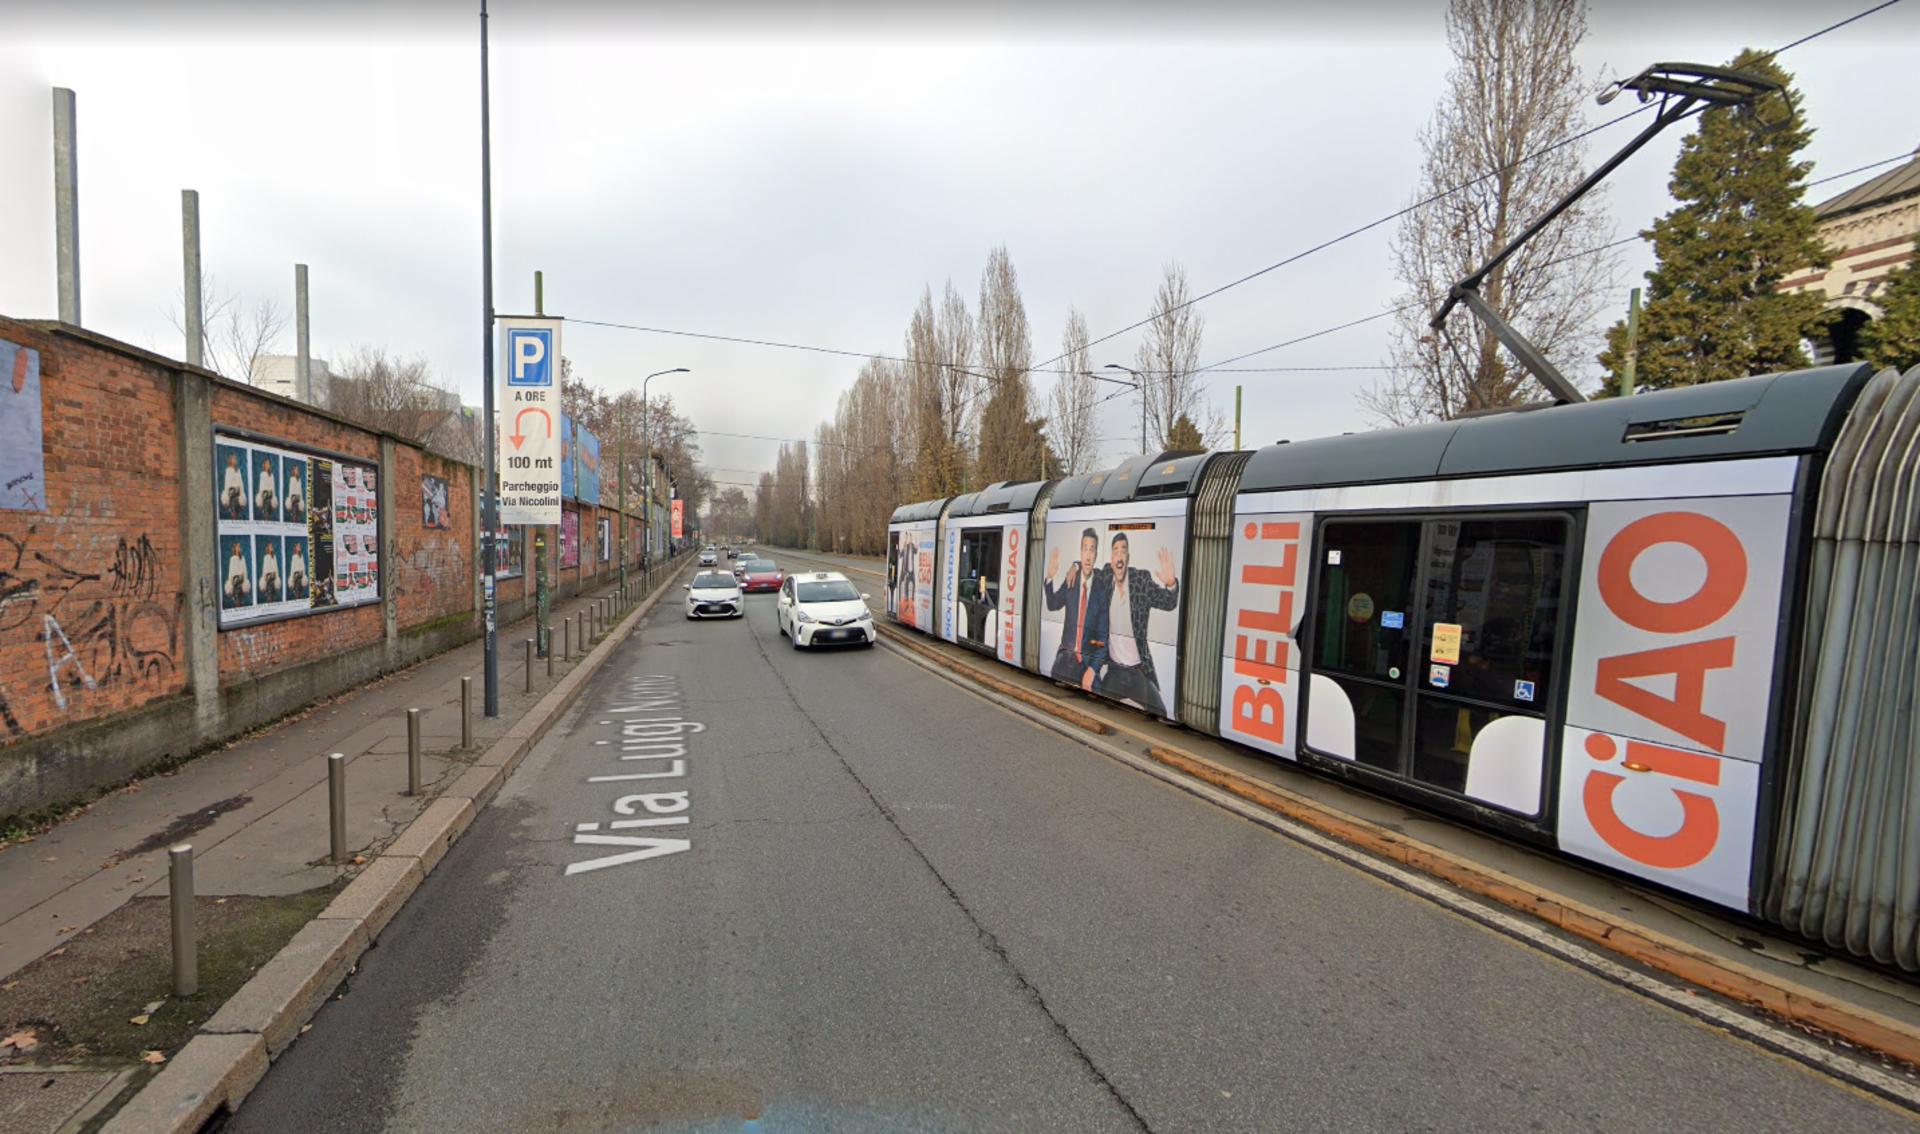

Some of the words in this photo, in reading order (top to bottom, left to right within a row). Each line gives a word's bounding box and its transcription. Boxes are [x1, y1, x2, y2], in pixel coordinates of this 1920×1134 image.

[515, 336, 545, 379] P
[514, 391, 523, 402] A
[525, 391, 546, 402] ORE
[507, 456, 530, 469] 100
[535, 457, 553, 469] mt
[502, 481, 559, 494] Parcheggio
[502, 496, 517, 506] Via
[519, 496, 559, 506] Niccolini
[586, 716, 707, 783] Luigi
[564, 790, 691, 876] Via
